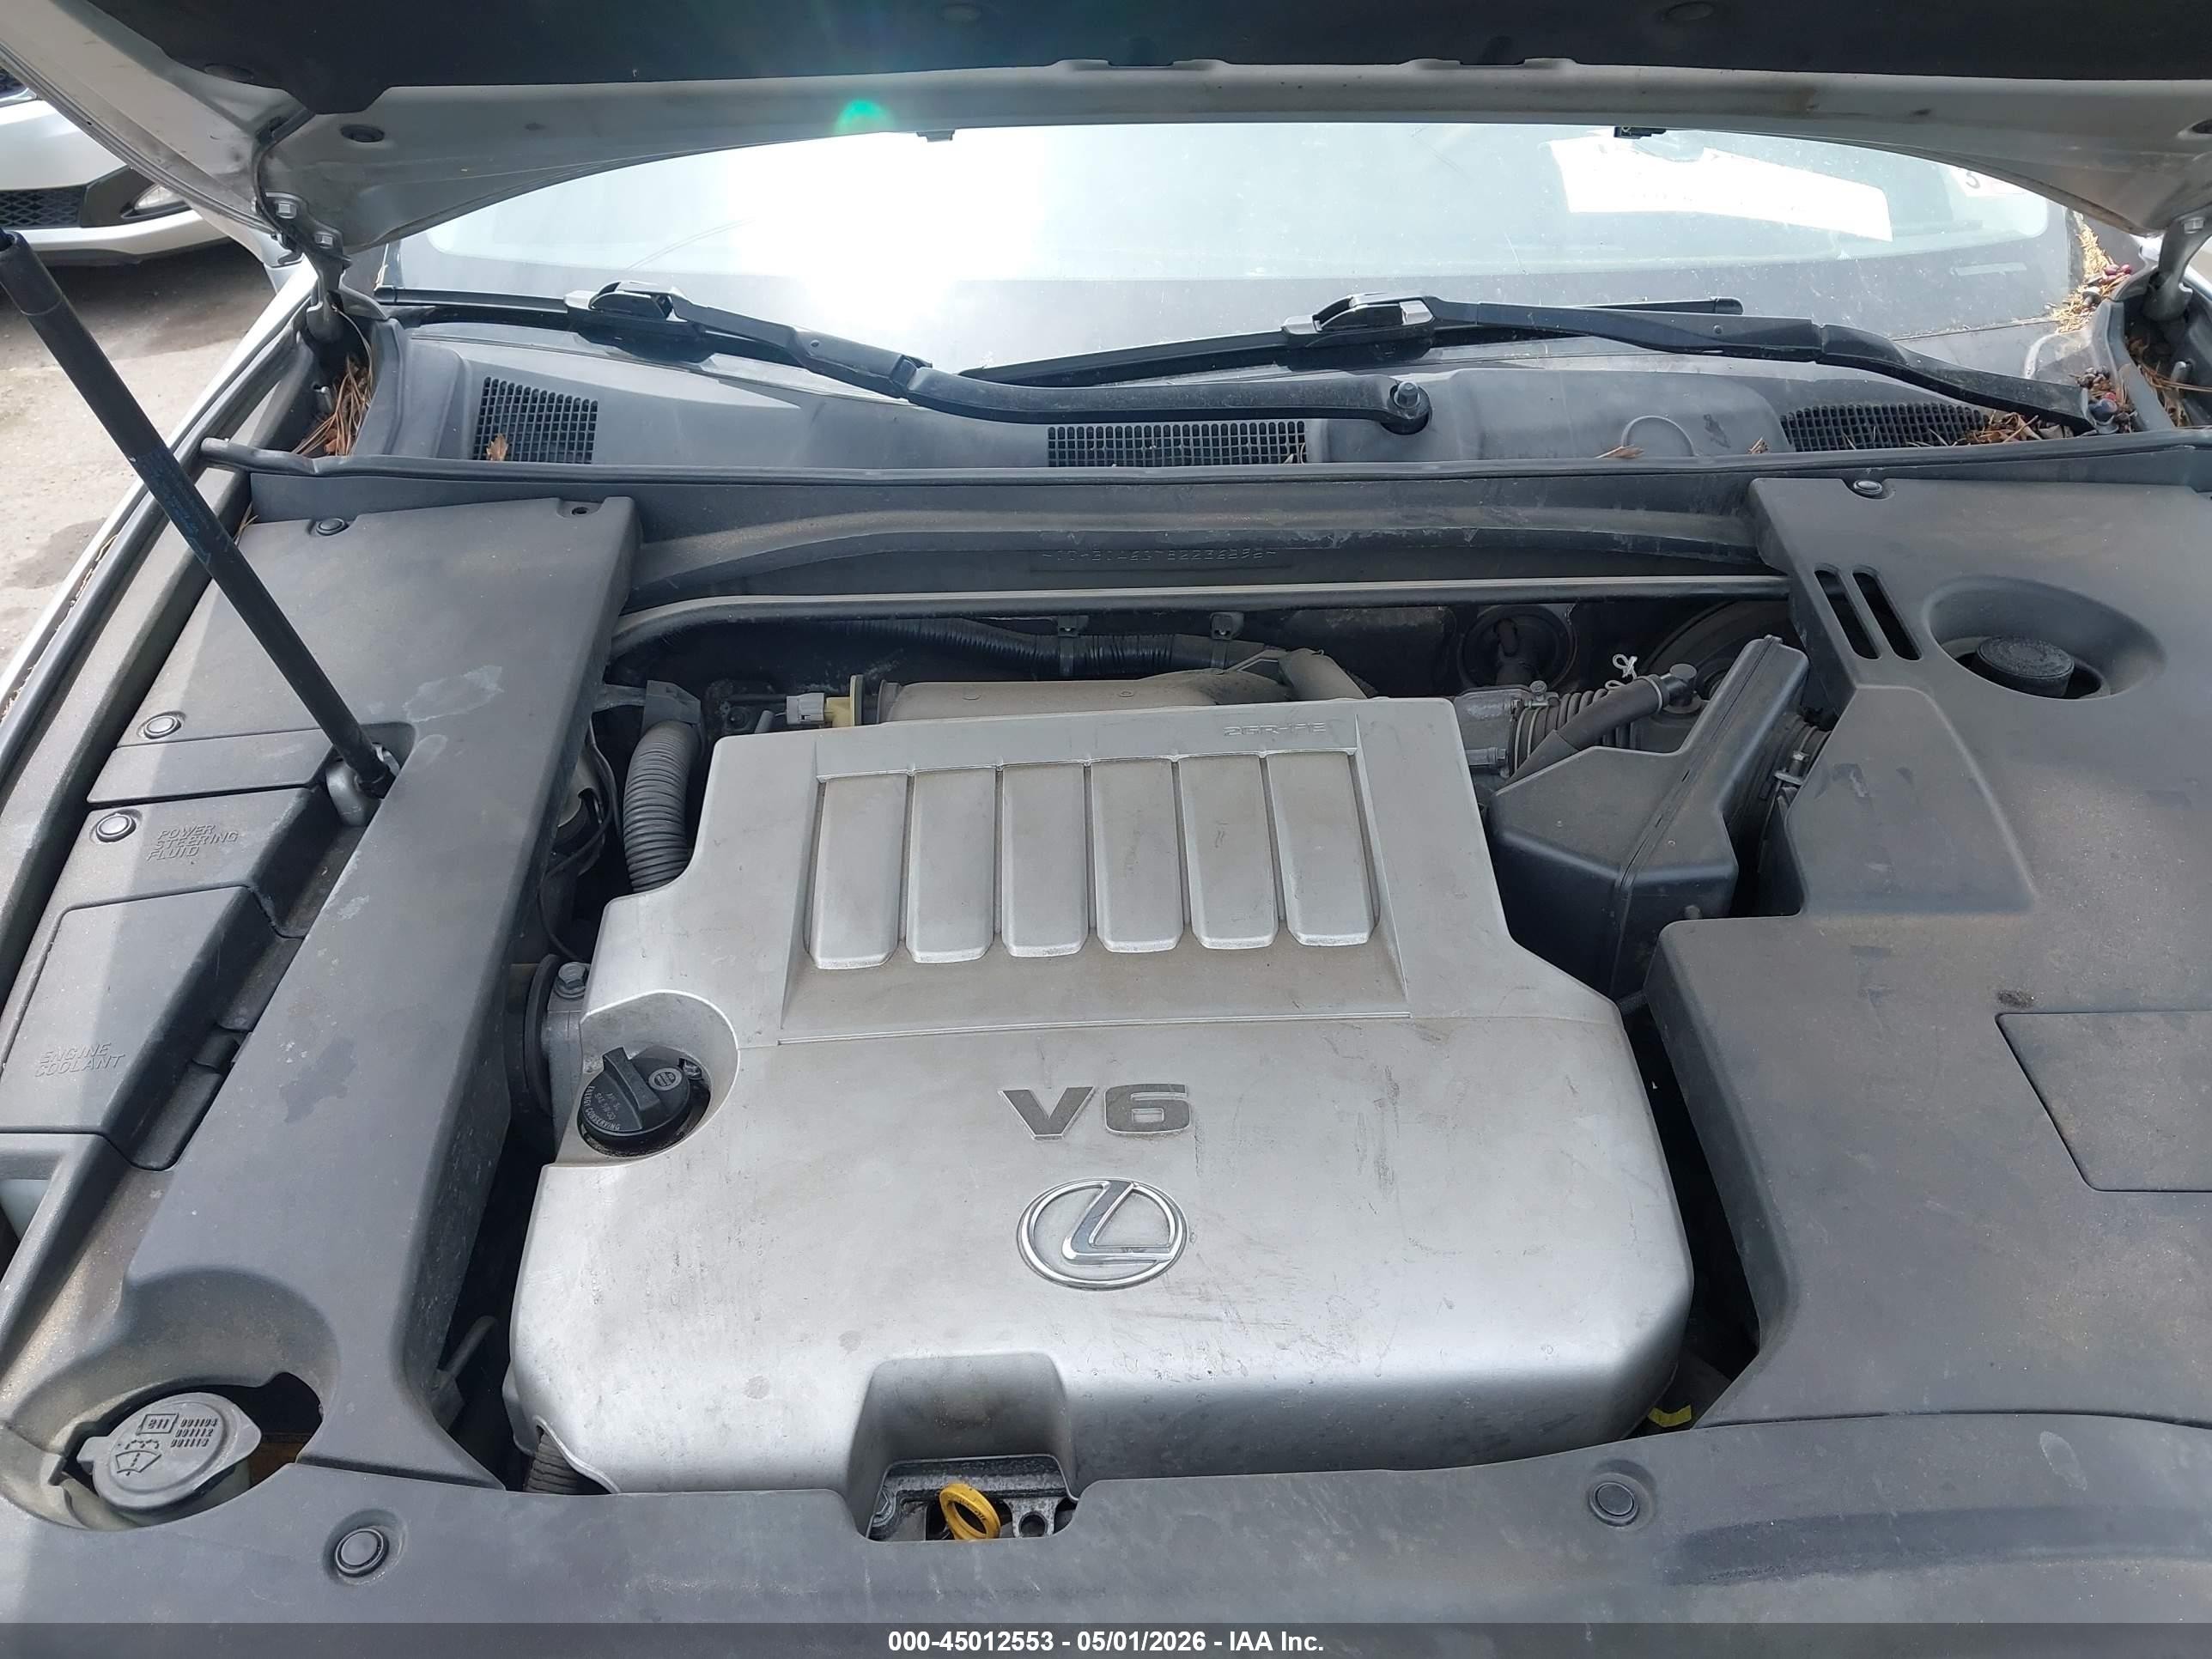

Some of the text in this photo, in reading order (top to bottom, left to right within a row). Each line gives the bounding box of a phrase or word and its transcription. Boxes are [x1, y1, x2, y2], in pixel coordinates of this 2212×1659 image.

[153, 830, 240, 850] STEERING
[157, 823, 216, 841] POWER
[145, 846, 200, 862] FLUID
[40, 1042, 112, 1065] ENGINE
[34, 1053, 126, 1078] COOLANT
[585, 1108, 620, 1131] CONSERVING
[998, 1084, 1191, 1140] V6
